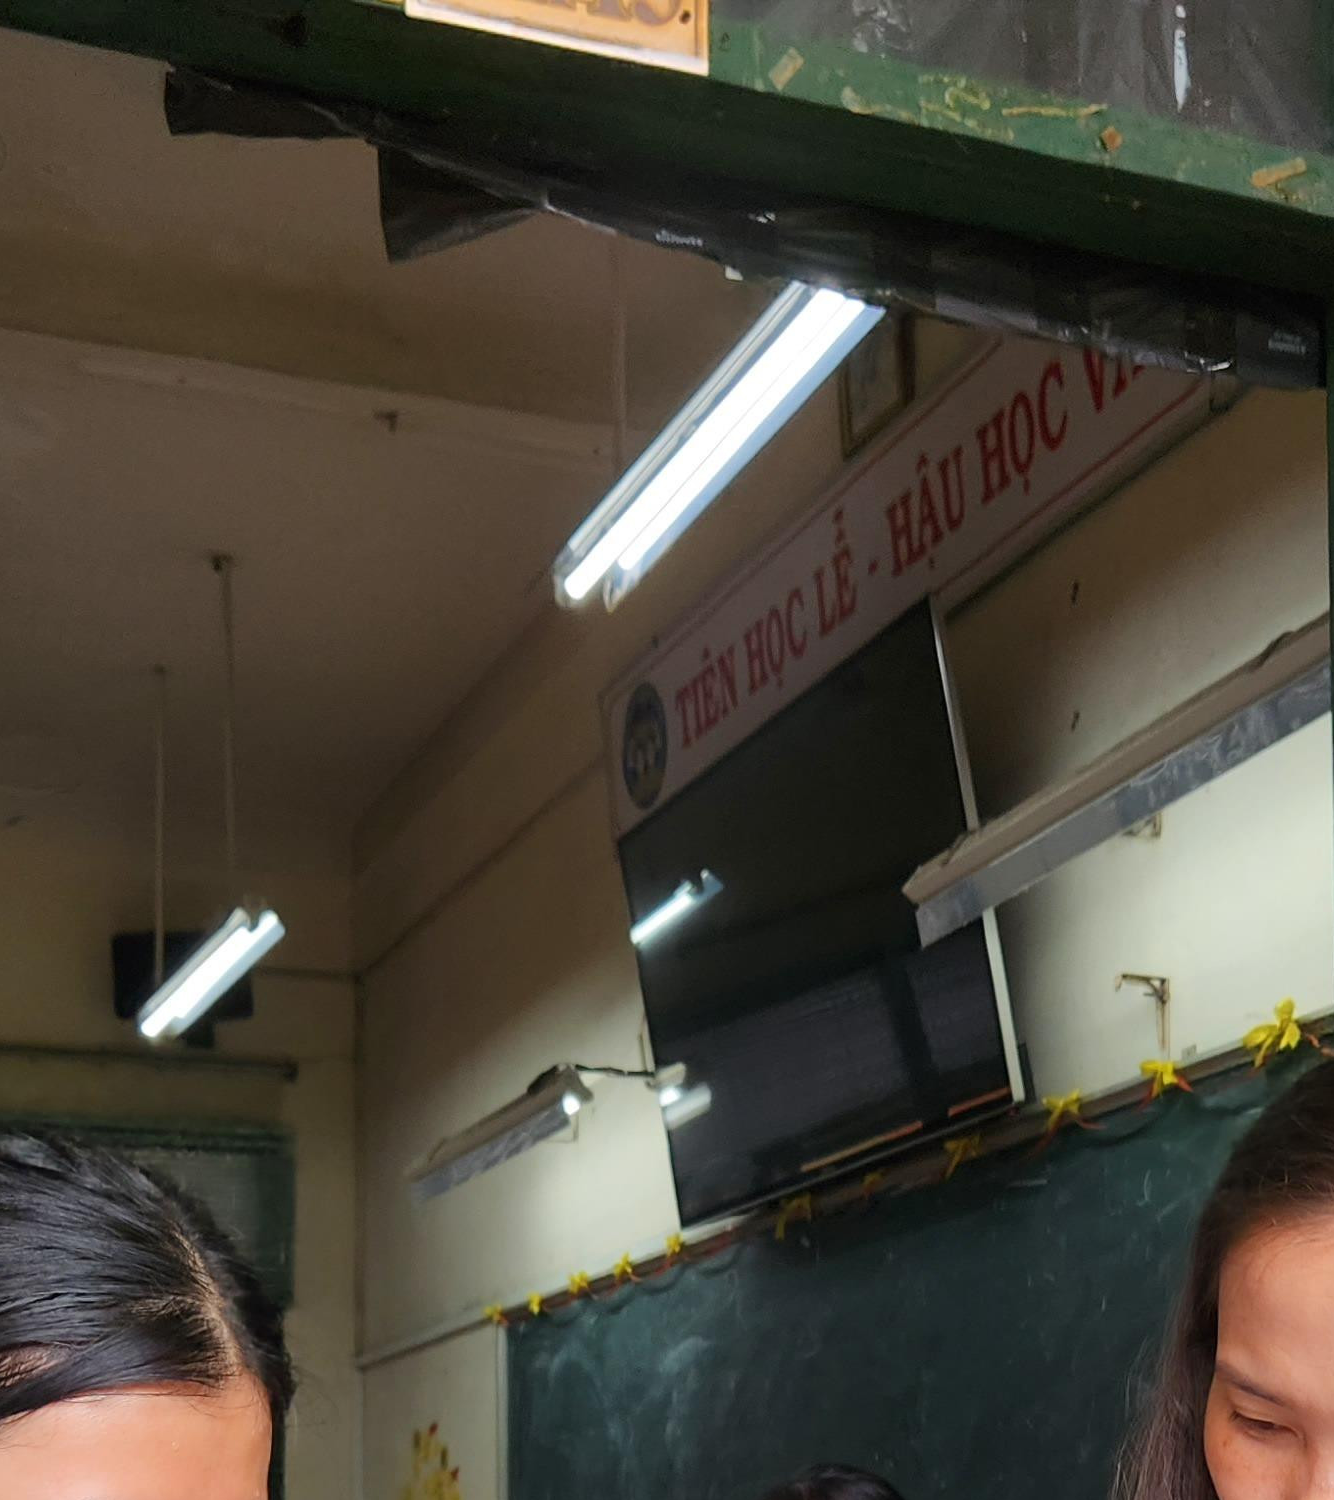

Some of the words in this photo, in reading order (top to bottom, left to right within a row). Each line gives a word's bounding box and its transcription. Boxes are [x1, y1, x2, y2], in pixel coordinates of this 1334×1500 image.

[743, 587, 808, 694] HỌC
[885, 453, 967, 578] HẬU
[975, 360, 1068, 506] HỌC
